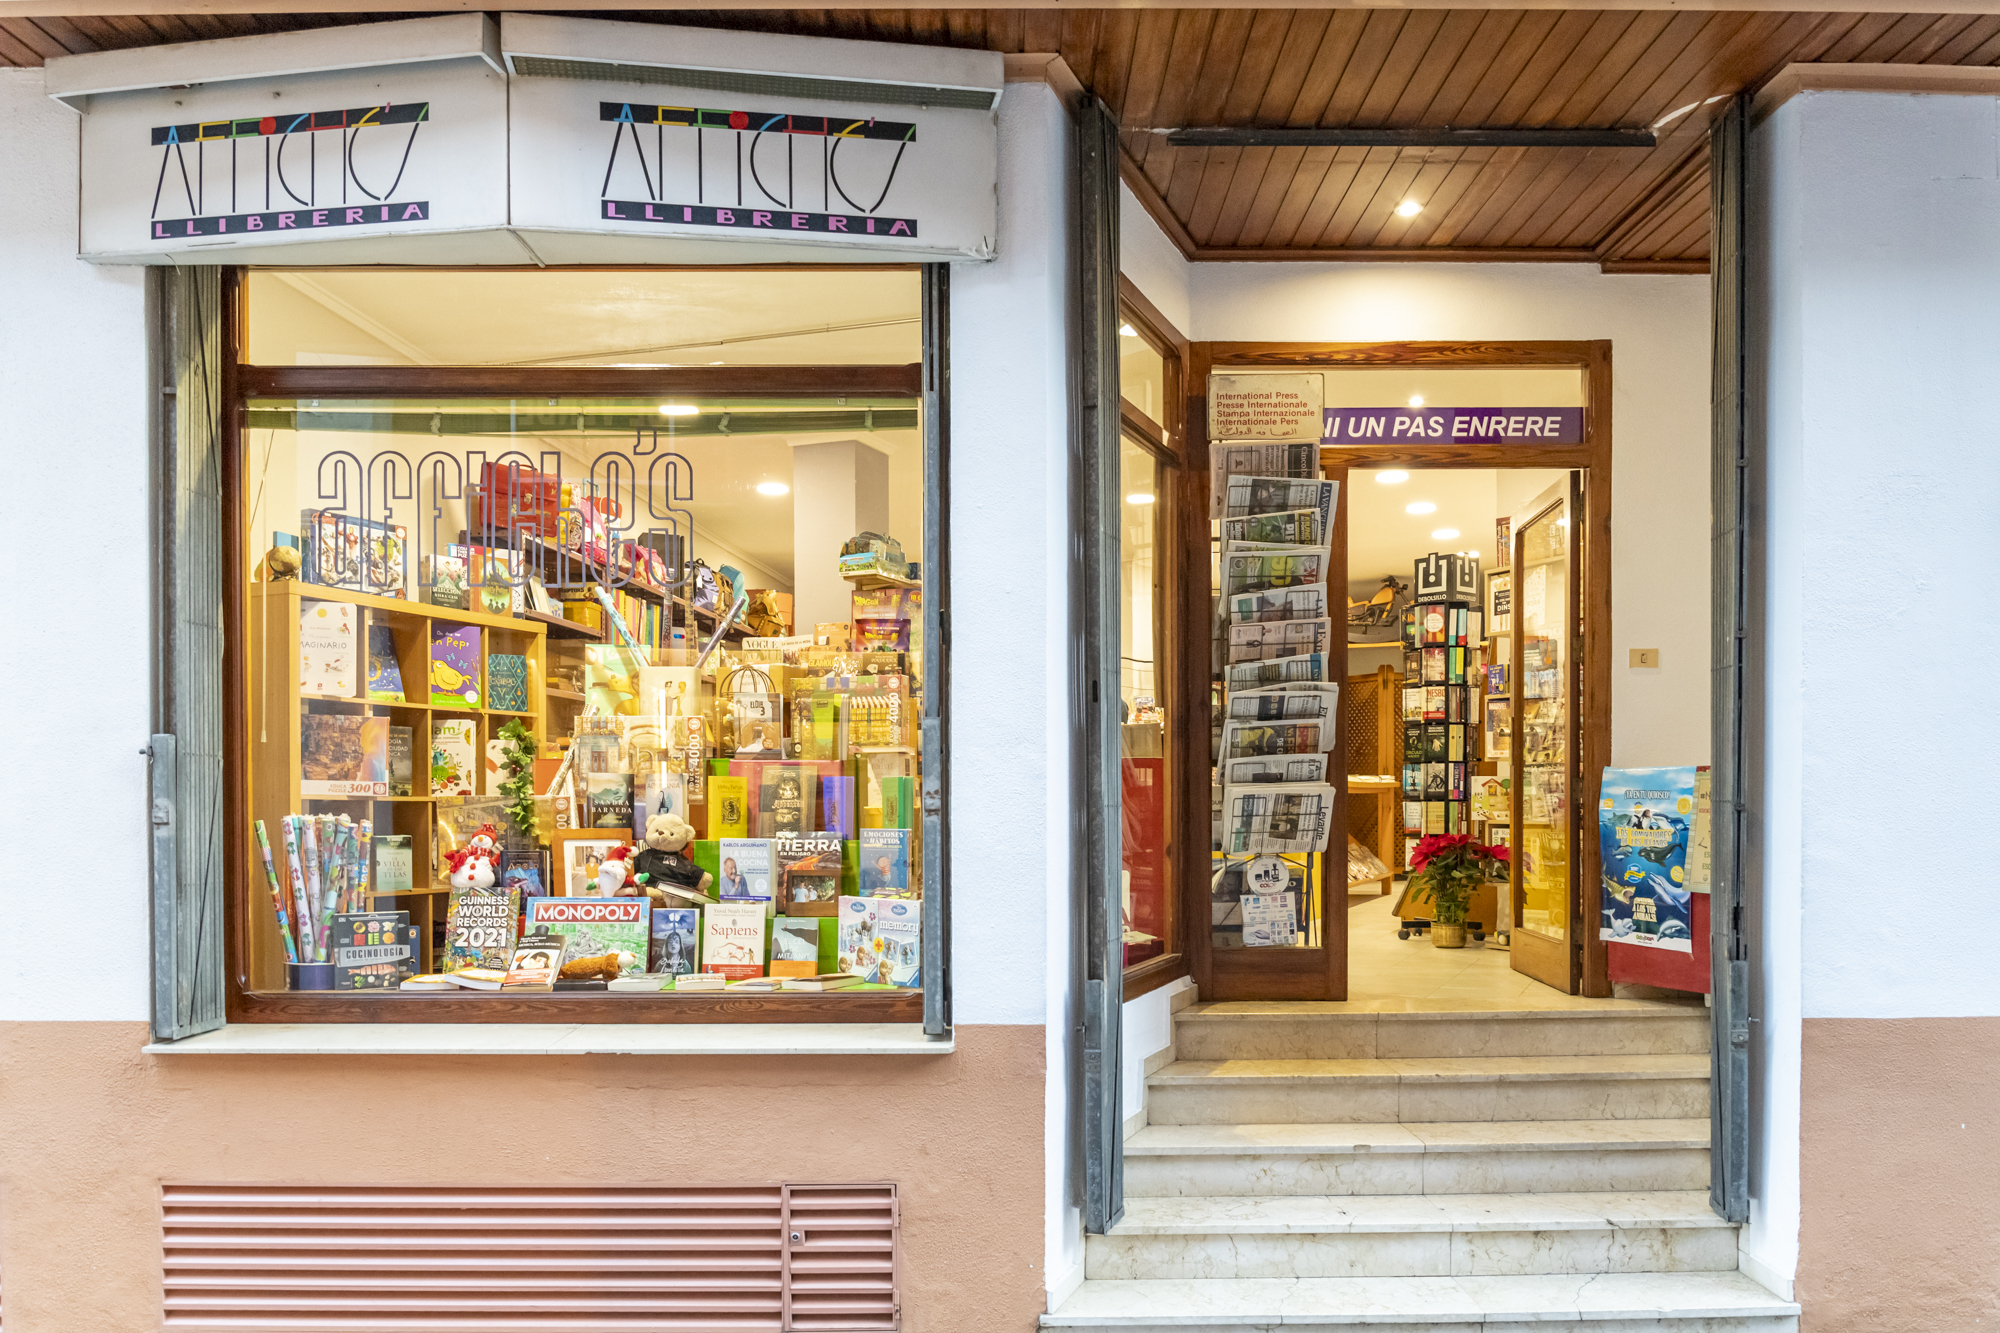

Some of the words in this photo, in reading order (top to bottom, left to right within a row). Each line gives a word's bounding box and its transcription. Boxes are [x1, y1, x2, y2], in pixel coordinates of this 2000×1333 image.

[155, 203, 424, 238] LLIBRERIA
[606, 202, 911, 236] LLIBRERIA
[1216, 392, 1272, 400] International
[1276, 392, 1299, 400] Press
[1216, 401, 1245, 409] Presse
[1247, 401, 1308, 409] Internationale
[1216, 410, 1250, 418] Stampa
[1253, 409, 1315, 417] Internazionale
[1216, 418, 1277, 426] Internationale
[1347, 416, 1386, 438] UN
[1391, 416, 1445, 438] PAS
[1451, 416, 1562, 437] ENRERE
[1417, 594, 1447, 602] DEBOLSILLO
[746, 640, 779, 649] VOGUE
[760, 706, 765, 716] 3
[888, 692, 899, 723] 4000
[689, 734, 700, 765] 4000
[348, 783, 371, 794] 300
[1316, 806, 1330, 841] Levante
[1616, 828, 1628, 838] LOS
[1630, 829, 1672, 840] DOMINADORES
[777, 839, 842, 852] TIERRA
[1630, 838, 1642, 846] LOS
[730, 850, 739, 858] LA
[741, 850, 768, 858] BUENA
[738, 859, 769, 867] COCINA
[458, 896, 510, 906] GUINNESS
[458, 905, 509, 917] WORLD
[537, 905, 639, 920] MONOPOLY
[456, 918, 508, 927] RECORDS
[710, 923, 758, 940] Sapiens
[880, 921, 919, 936] memory
[454, 927, 507, 948] 2021
[346, 945, 404, 959] COCINOLOGÍA
[777, 952, 810, 960] MITJANIT
